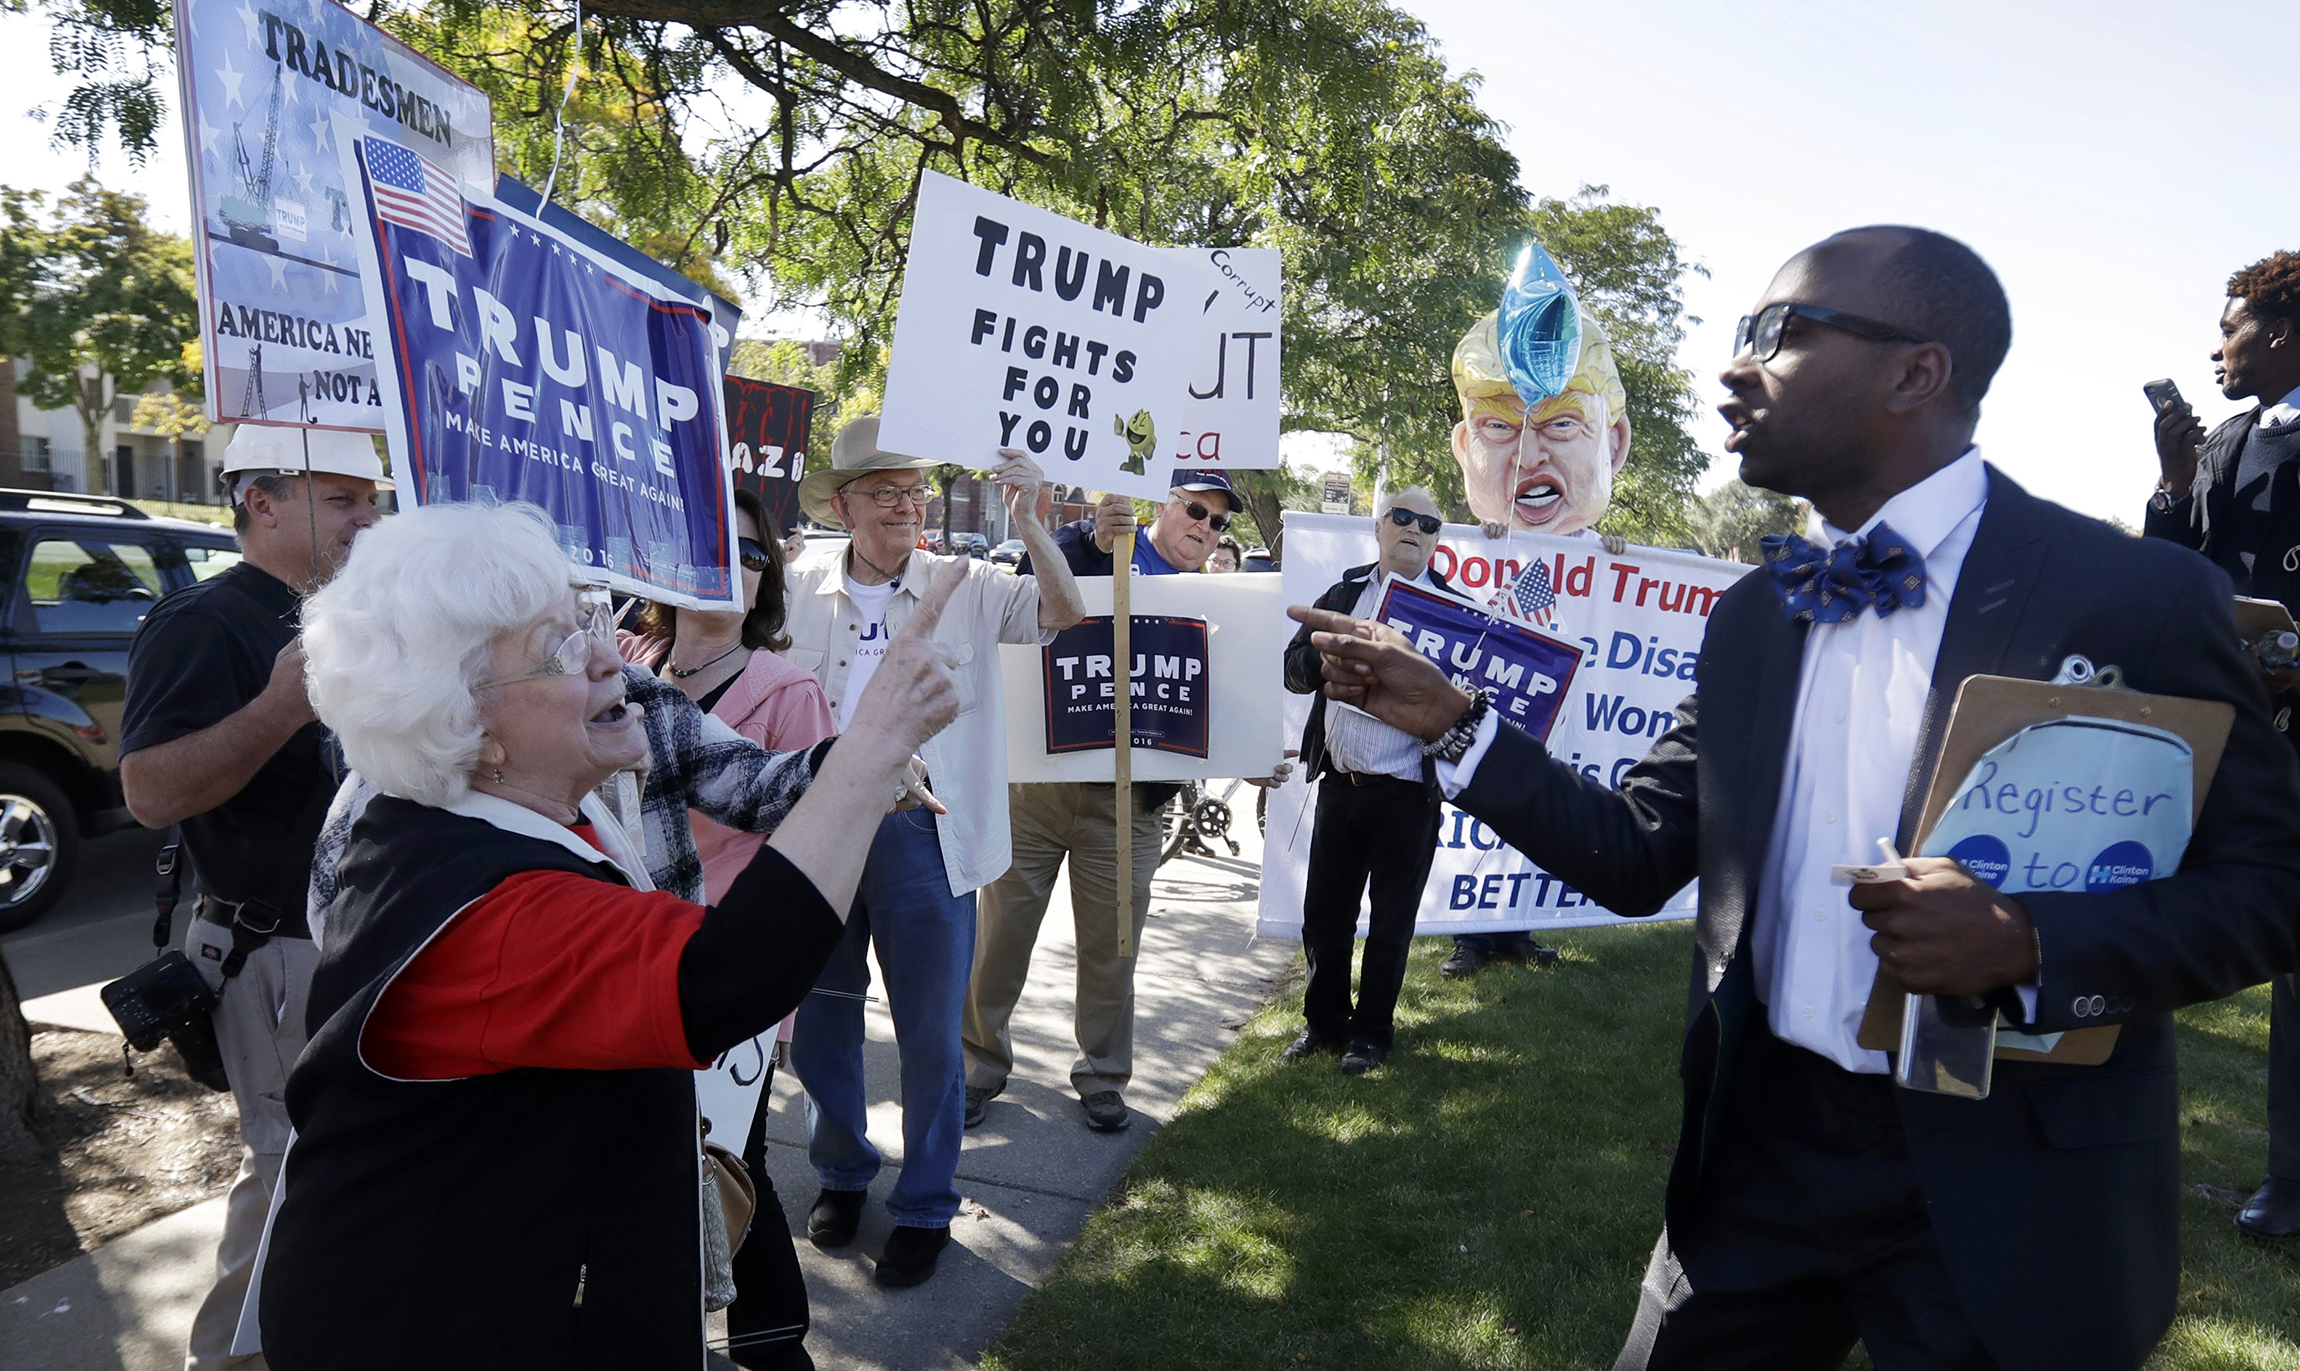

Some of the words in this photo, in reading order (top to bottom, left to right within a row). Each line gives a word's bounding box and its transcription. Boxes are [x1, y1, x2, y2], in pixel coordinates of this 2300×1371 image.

[258, 8, 451, 148] TRADESMEN
[275, 208, 306, 228] TRUMP
[974, 215, 1165, 323] TRUMP
[1210, 249, 1276, 313] Corrupt
[217, 301, 341, 354] AMERICA
[403, 255, 698, 433] TRUMP
[971, 308, 1137, 383] FIGHTS
[313, 369, 361, 404] NOT
[1003, 366, 1092, 420] FOR
[456, 351, 676, 479] PENCE
[999, 411, 1089, 461] YOU
[445, 410, 493, 447] MAKE
[500, 434, 584, 475] AMERICA
[591, 461, 635, 493] GREAT
[640, 483, 685, 513] AGAIN!
[570, 544, 614, 569] 2016
[1427, 544, 1595, 598] Donld
[1067, 704, 1093, 714] MAKE
[1141, 703, 1168, 712] GREAT
[1169, 706, 1193, 716] AGAIN!
[1071, 682, 1191, 702] PENCE
[1133, 737, 1153, 746] 016
[1962, 761, 2173, 838] Register
[1969, 859, 2008, 871] Clinton
[2023, 852, 2081, 889] to
[2109, 874, 2139, 884] Kaine
[2112, 864, 2149, 876] Clinton
[1450, 872, 1600, 910] BETTE
